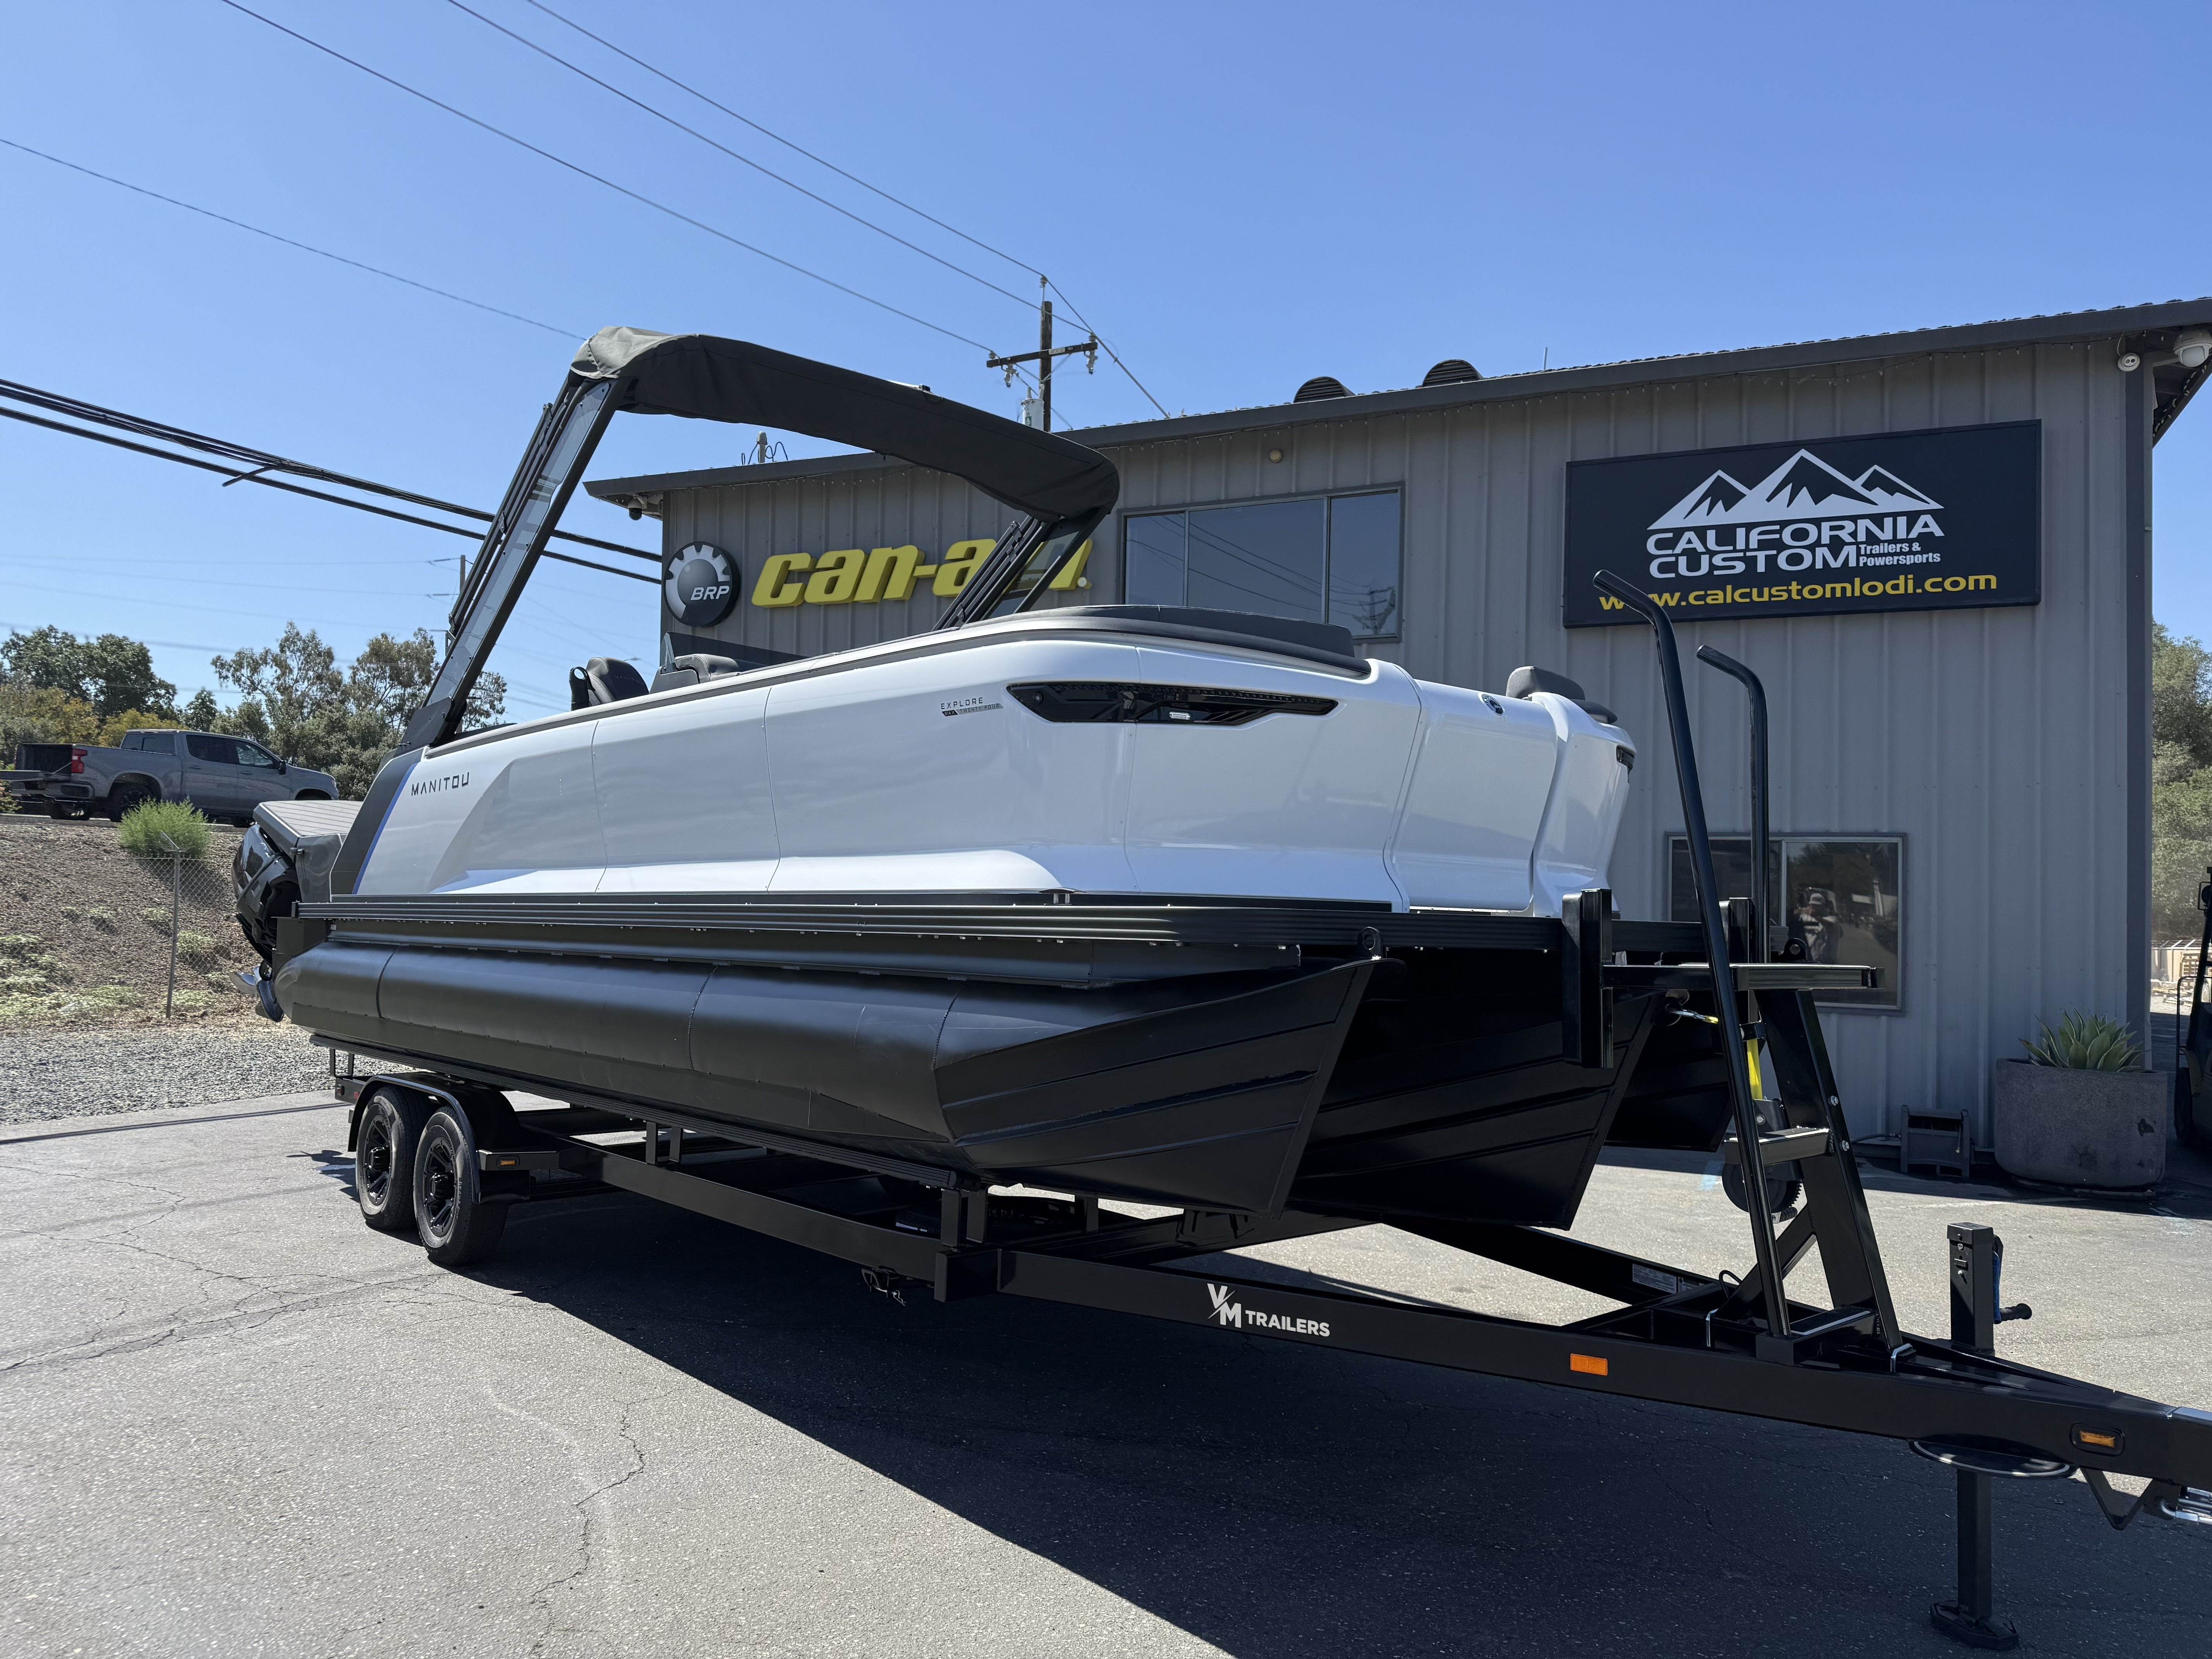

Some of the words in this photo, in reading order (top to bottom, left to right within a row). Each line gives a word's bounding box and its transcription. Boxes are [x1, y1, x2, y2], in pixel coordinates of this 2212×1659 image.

[1646, 514, 1945, 555] CALIFORNIA
[1858, 543, 1909, 555] Trailers
[1911, 542, 1921, 551] &
[1859, 553, 1941, 567] Powersports
[1649, 544, 1857, 578] CUSTOM
[690, 585, 730, 601] BRP
[1599, 575, 1997, 610] ww.calcustomlodi.com
[941, 697, 983, 709] EXPLORE
[411, 772, 469, 796] MANITOU
[1245, 1310, 1330, 1337] TRAILERS
